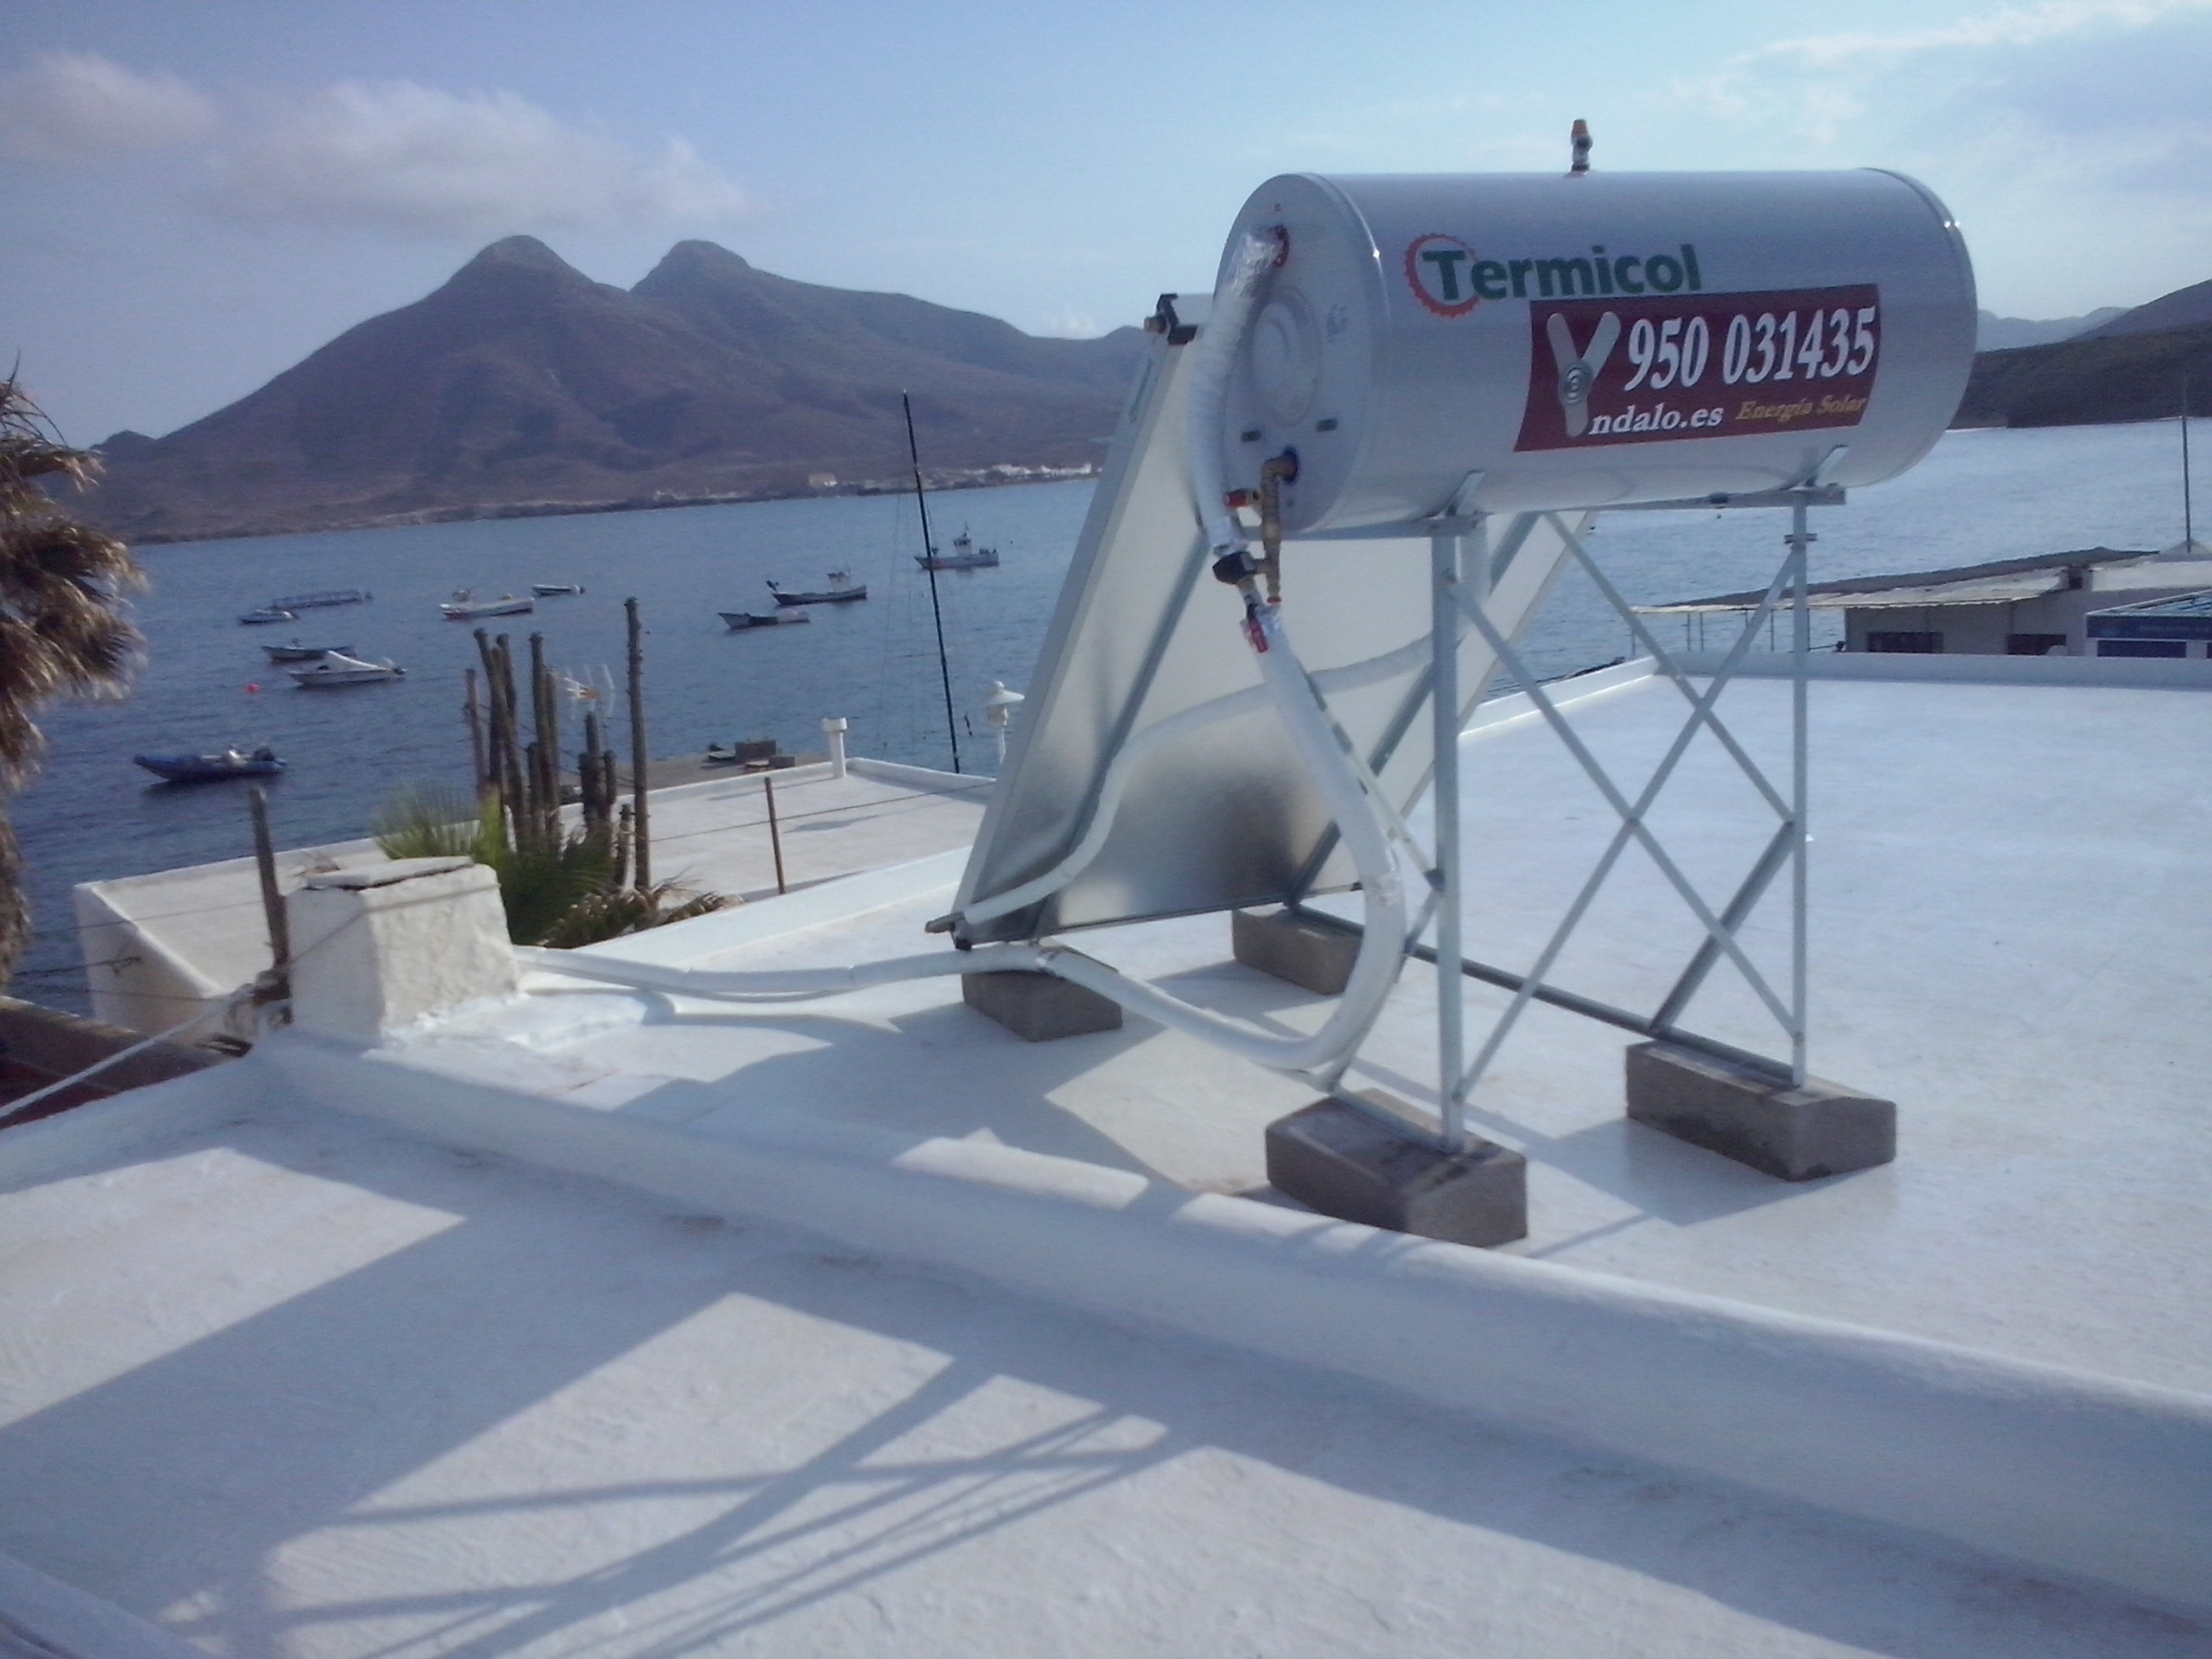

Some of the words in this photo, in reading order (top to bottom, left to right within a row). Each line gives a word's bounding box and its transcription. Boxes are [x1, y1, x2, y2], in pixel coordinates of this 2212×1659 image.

[1421, 244, 1703, 301] Termicol
[1624, 315, 1710, 391] 950
[1723, 305, 1877, 385] 031435
